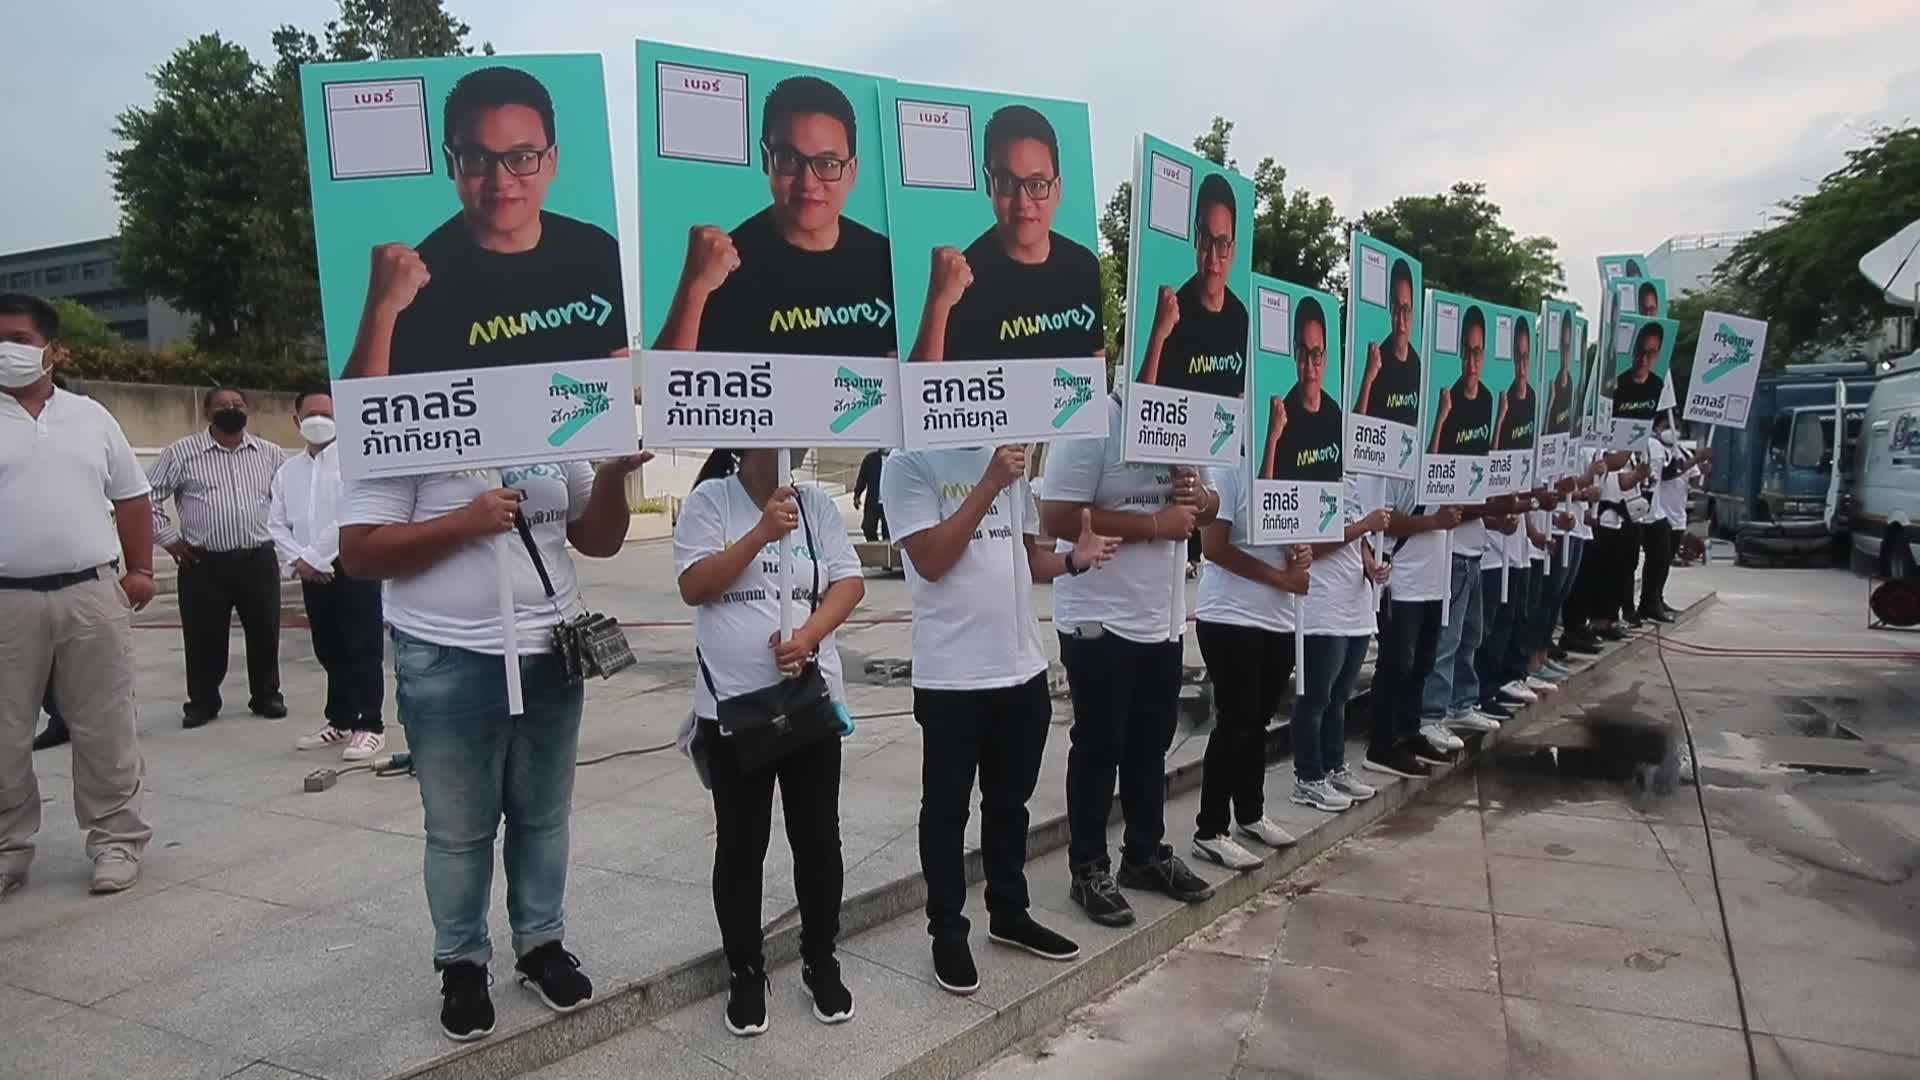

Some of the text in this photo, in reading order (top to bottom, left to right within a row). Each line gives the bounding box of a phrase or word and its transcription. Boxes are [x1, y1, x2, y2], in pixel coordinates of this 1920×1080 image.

[355, 88, 394, 104] เบอร์
[684, 78, 721, 92] เบอร์
[919, 112, 949, 124] เบอร์
[548, 381, 609, 401] กรุงเทพ
[667, 361, 773, 399] สกลธี
[833, 375, 884, 393] กรุงเทพ
[922, 366, 1006, 404] สกลธี
[361, 377, 478, 426] สกลธี
[1141, 396, 1188, 425] สกลธี
[666, 401, 774, 433] ภัททิยกุล
[923, 406, 1008, 433] ภัททิยกุล
[362, 426, 482, 456] ภัททิยกุล
[1138, 426, 1187, 452] ภัททิยกุล
[1355, 424, 1387, 446] สกลธี
[1262, 486, 1299, 512] สกลธี
